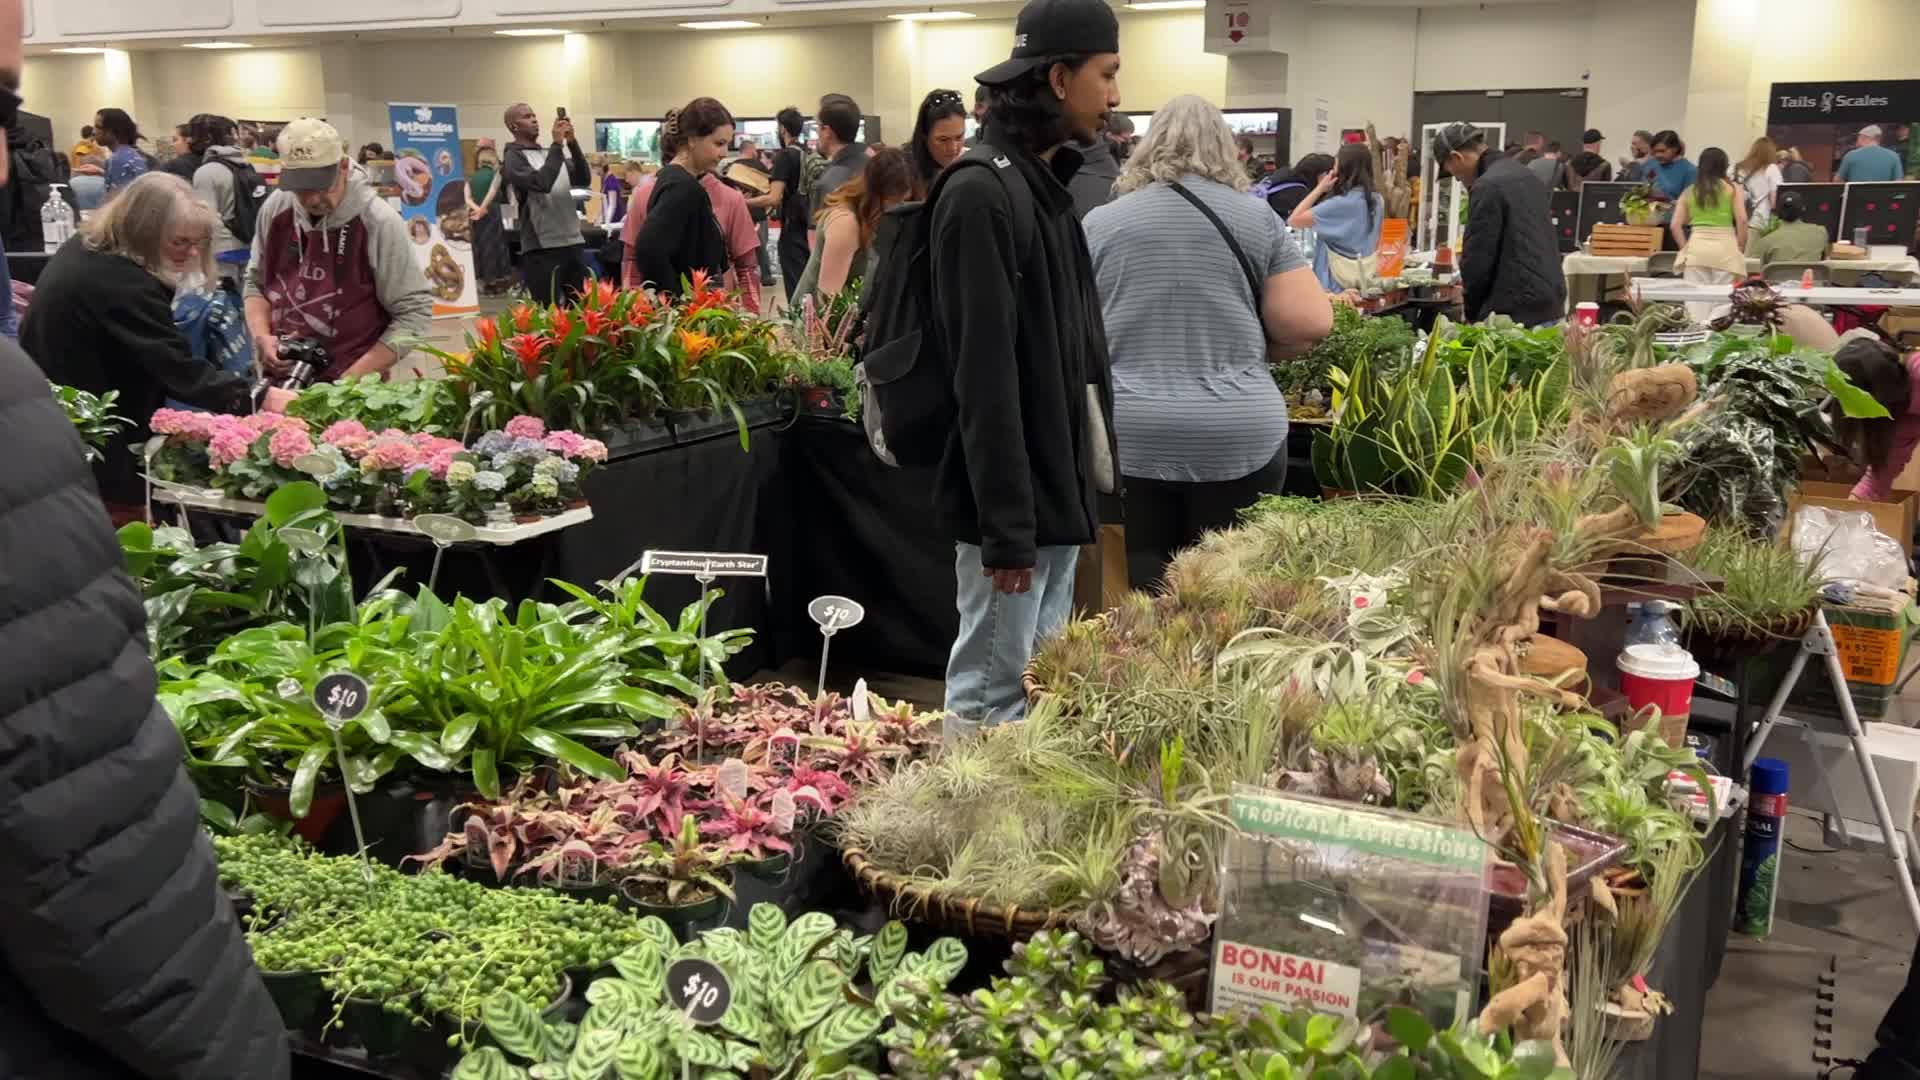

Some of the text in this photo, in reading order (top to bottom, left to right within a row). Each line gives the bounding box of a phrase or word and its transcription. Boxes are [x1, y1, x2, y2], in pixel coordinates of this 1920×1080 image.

[1225, 12, 1249, 27] 10
[1779, 94, 1889, 108] Tails Scales
[823, 604, 849, 621] $10
[328, 684, 357, 708] $10
[1237, 803, 1480, 862] TROPICAL EXPRESSIONS
[1221, 943, 1325, 985] BONSAI
[682, 972, 719, 1008] $10
[1232, 972, 1245, 985] IS
[1249, 975, 1280, 993] OUR
[1285, 983, 1350, 1009] PASSION
